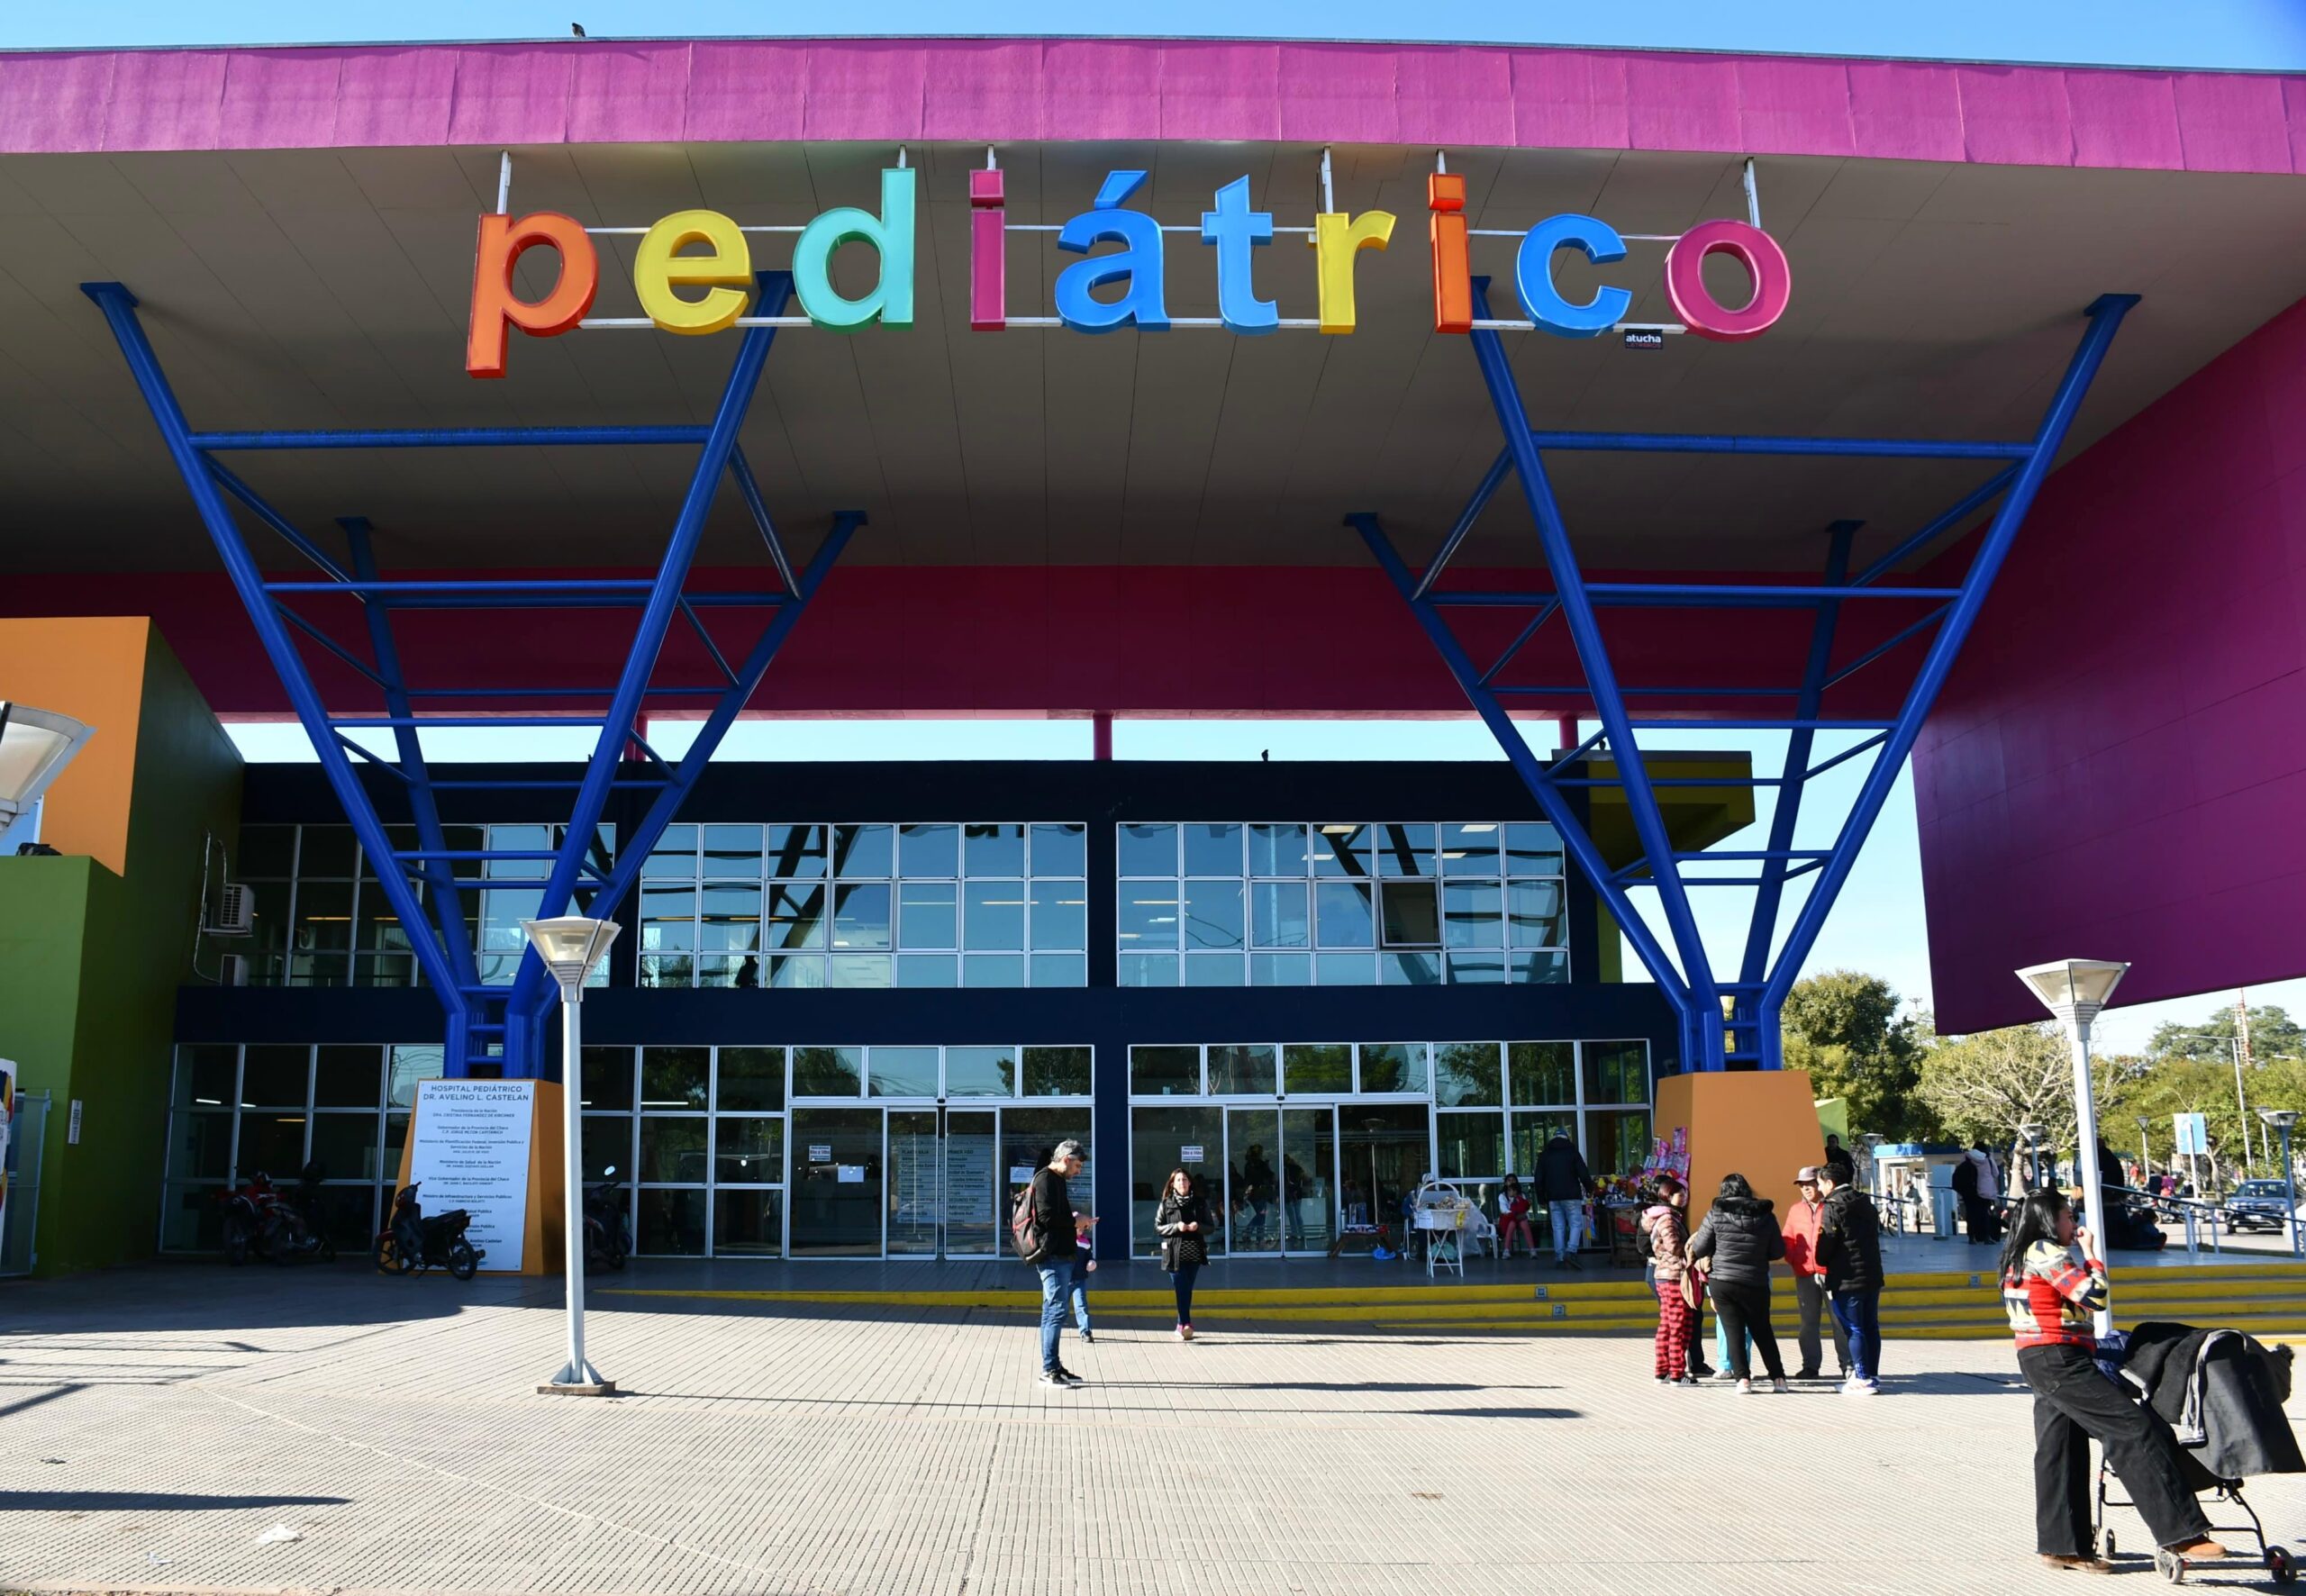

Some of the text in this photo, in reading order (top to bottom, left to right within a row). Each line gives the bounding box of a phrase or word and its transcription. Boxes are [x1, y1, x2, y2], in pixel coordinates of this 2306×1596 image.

[466, 167, 1791, 378] pediátrico
[1625, 334, 1662, 343] atucha
[473, 1084, 522, 1093] PEDIÁTRICO
